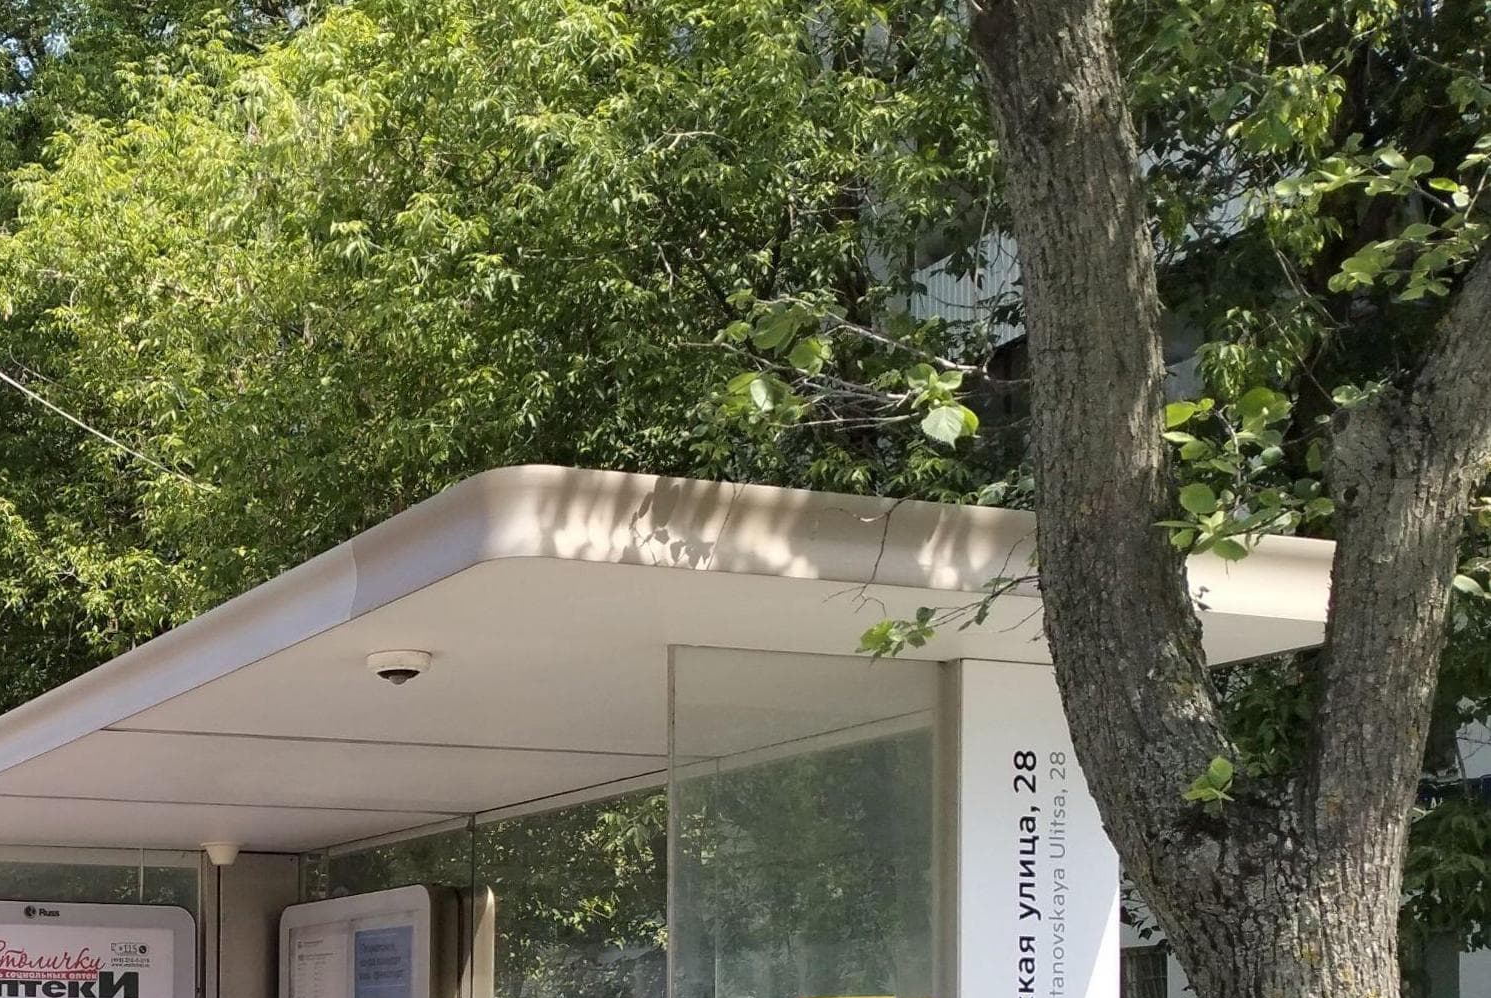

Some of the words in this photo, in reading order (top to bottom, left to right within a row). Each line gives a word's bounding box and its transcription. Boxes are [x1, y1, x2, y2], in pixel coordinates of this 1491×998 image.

[1013, 750, 1037, 794] 28
[1049, 751, 1066, 780] 28
[1049, 788, 1069, 859] Ulitsa,
[1019, 804, 1042, 921] улица,
[38, 907, 60, 918] Russ
